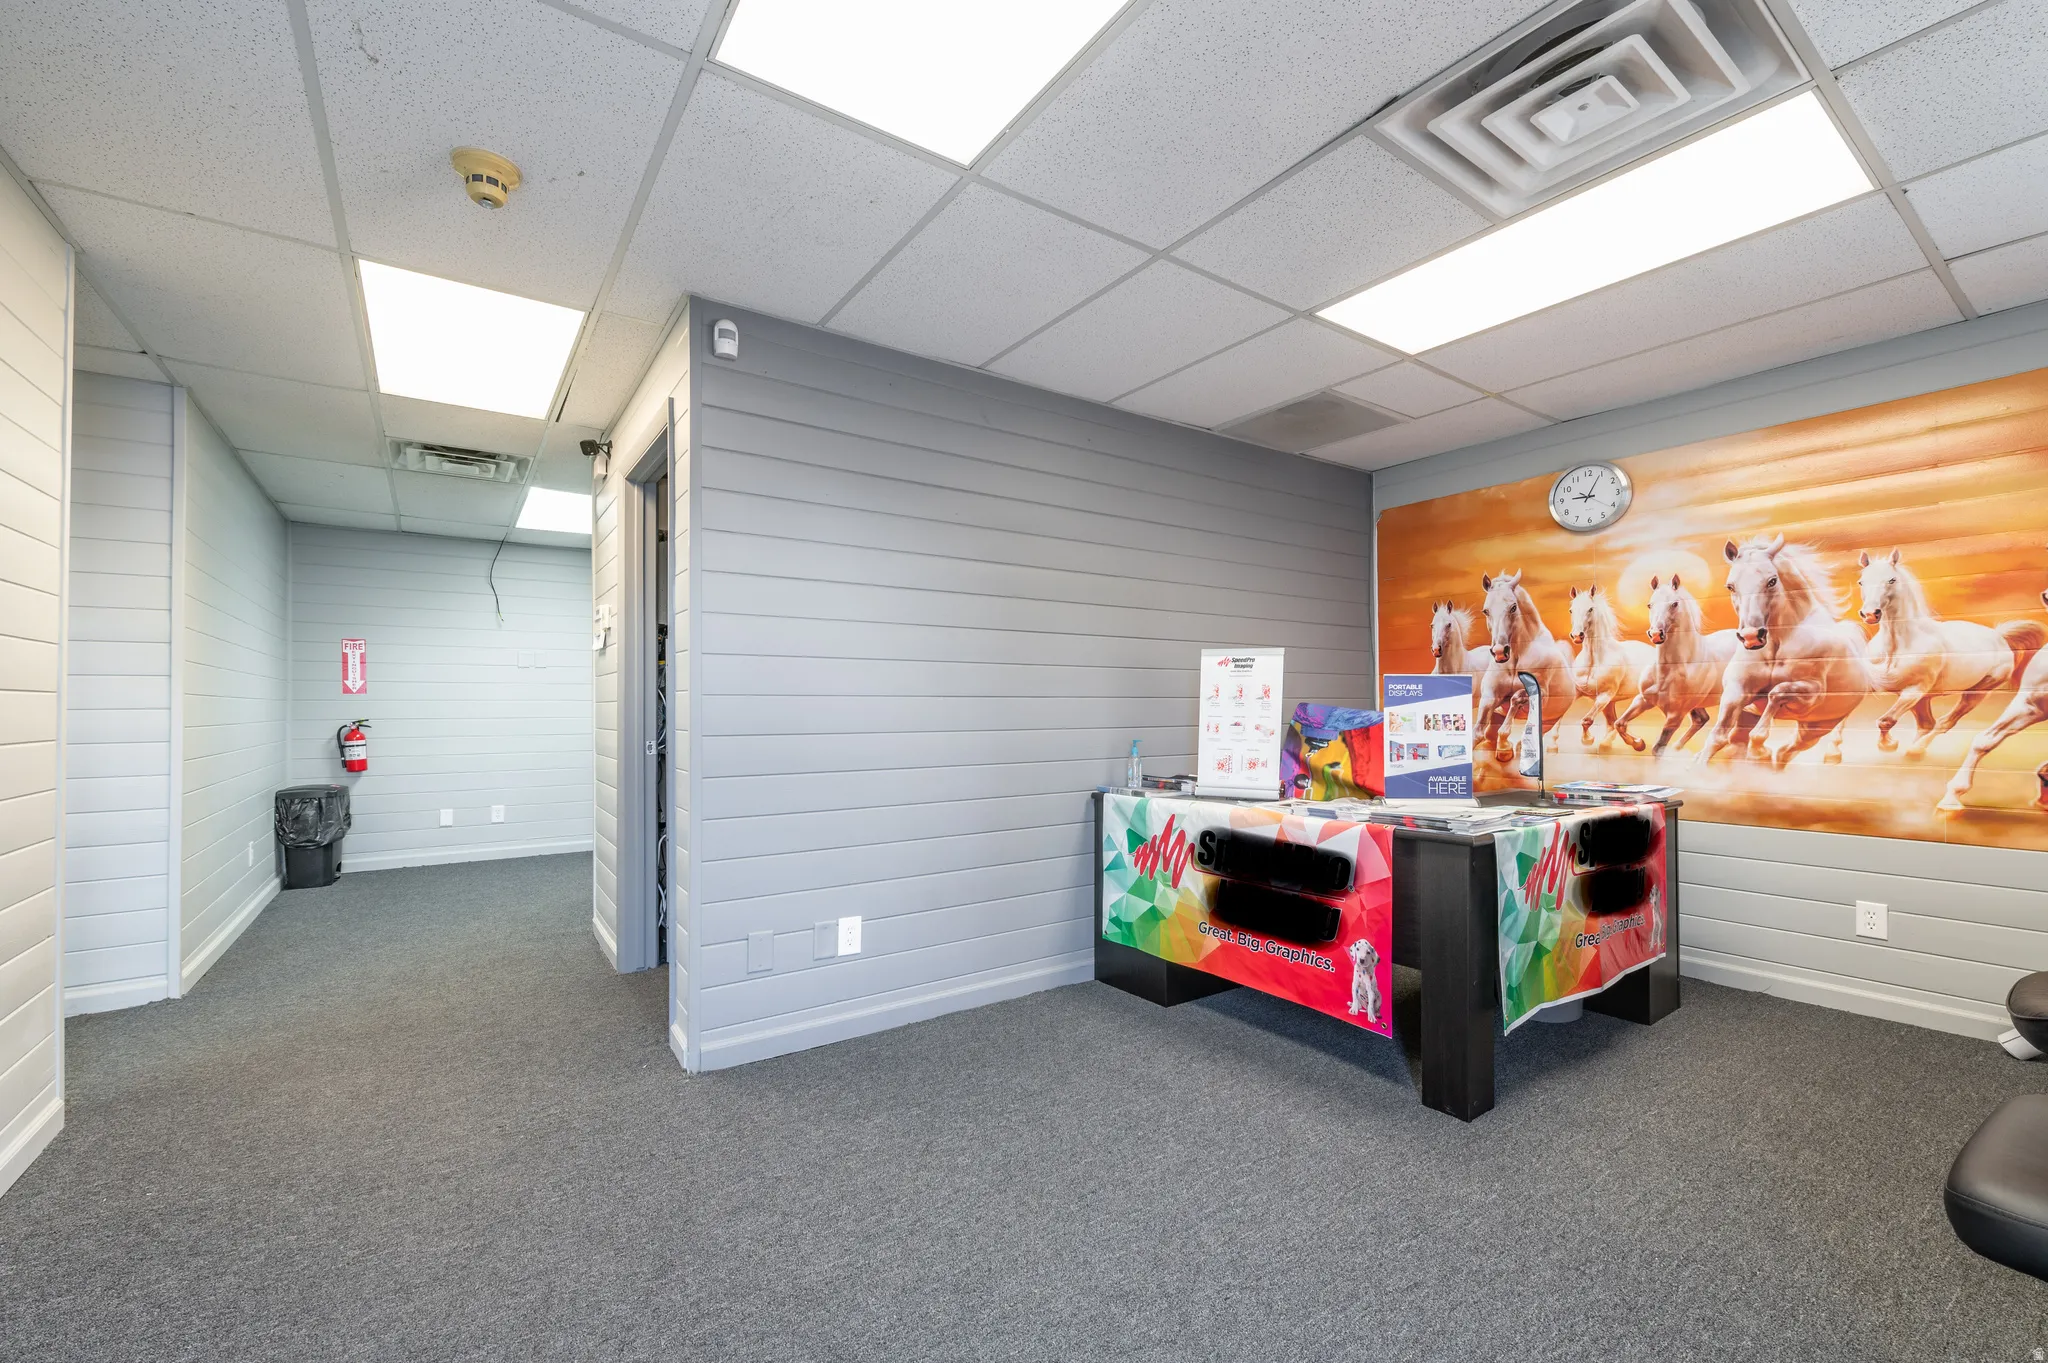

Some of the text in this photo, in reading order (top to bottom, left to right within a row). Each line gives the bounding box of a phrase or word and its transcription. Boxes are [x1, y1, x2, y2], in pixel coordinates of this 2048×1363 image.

[1428, 783, 1466, 794] HERE
[1198, 921, 1335, 972] Great. Big. Graphics.
[1575, 932, 1601, 948] Grea
